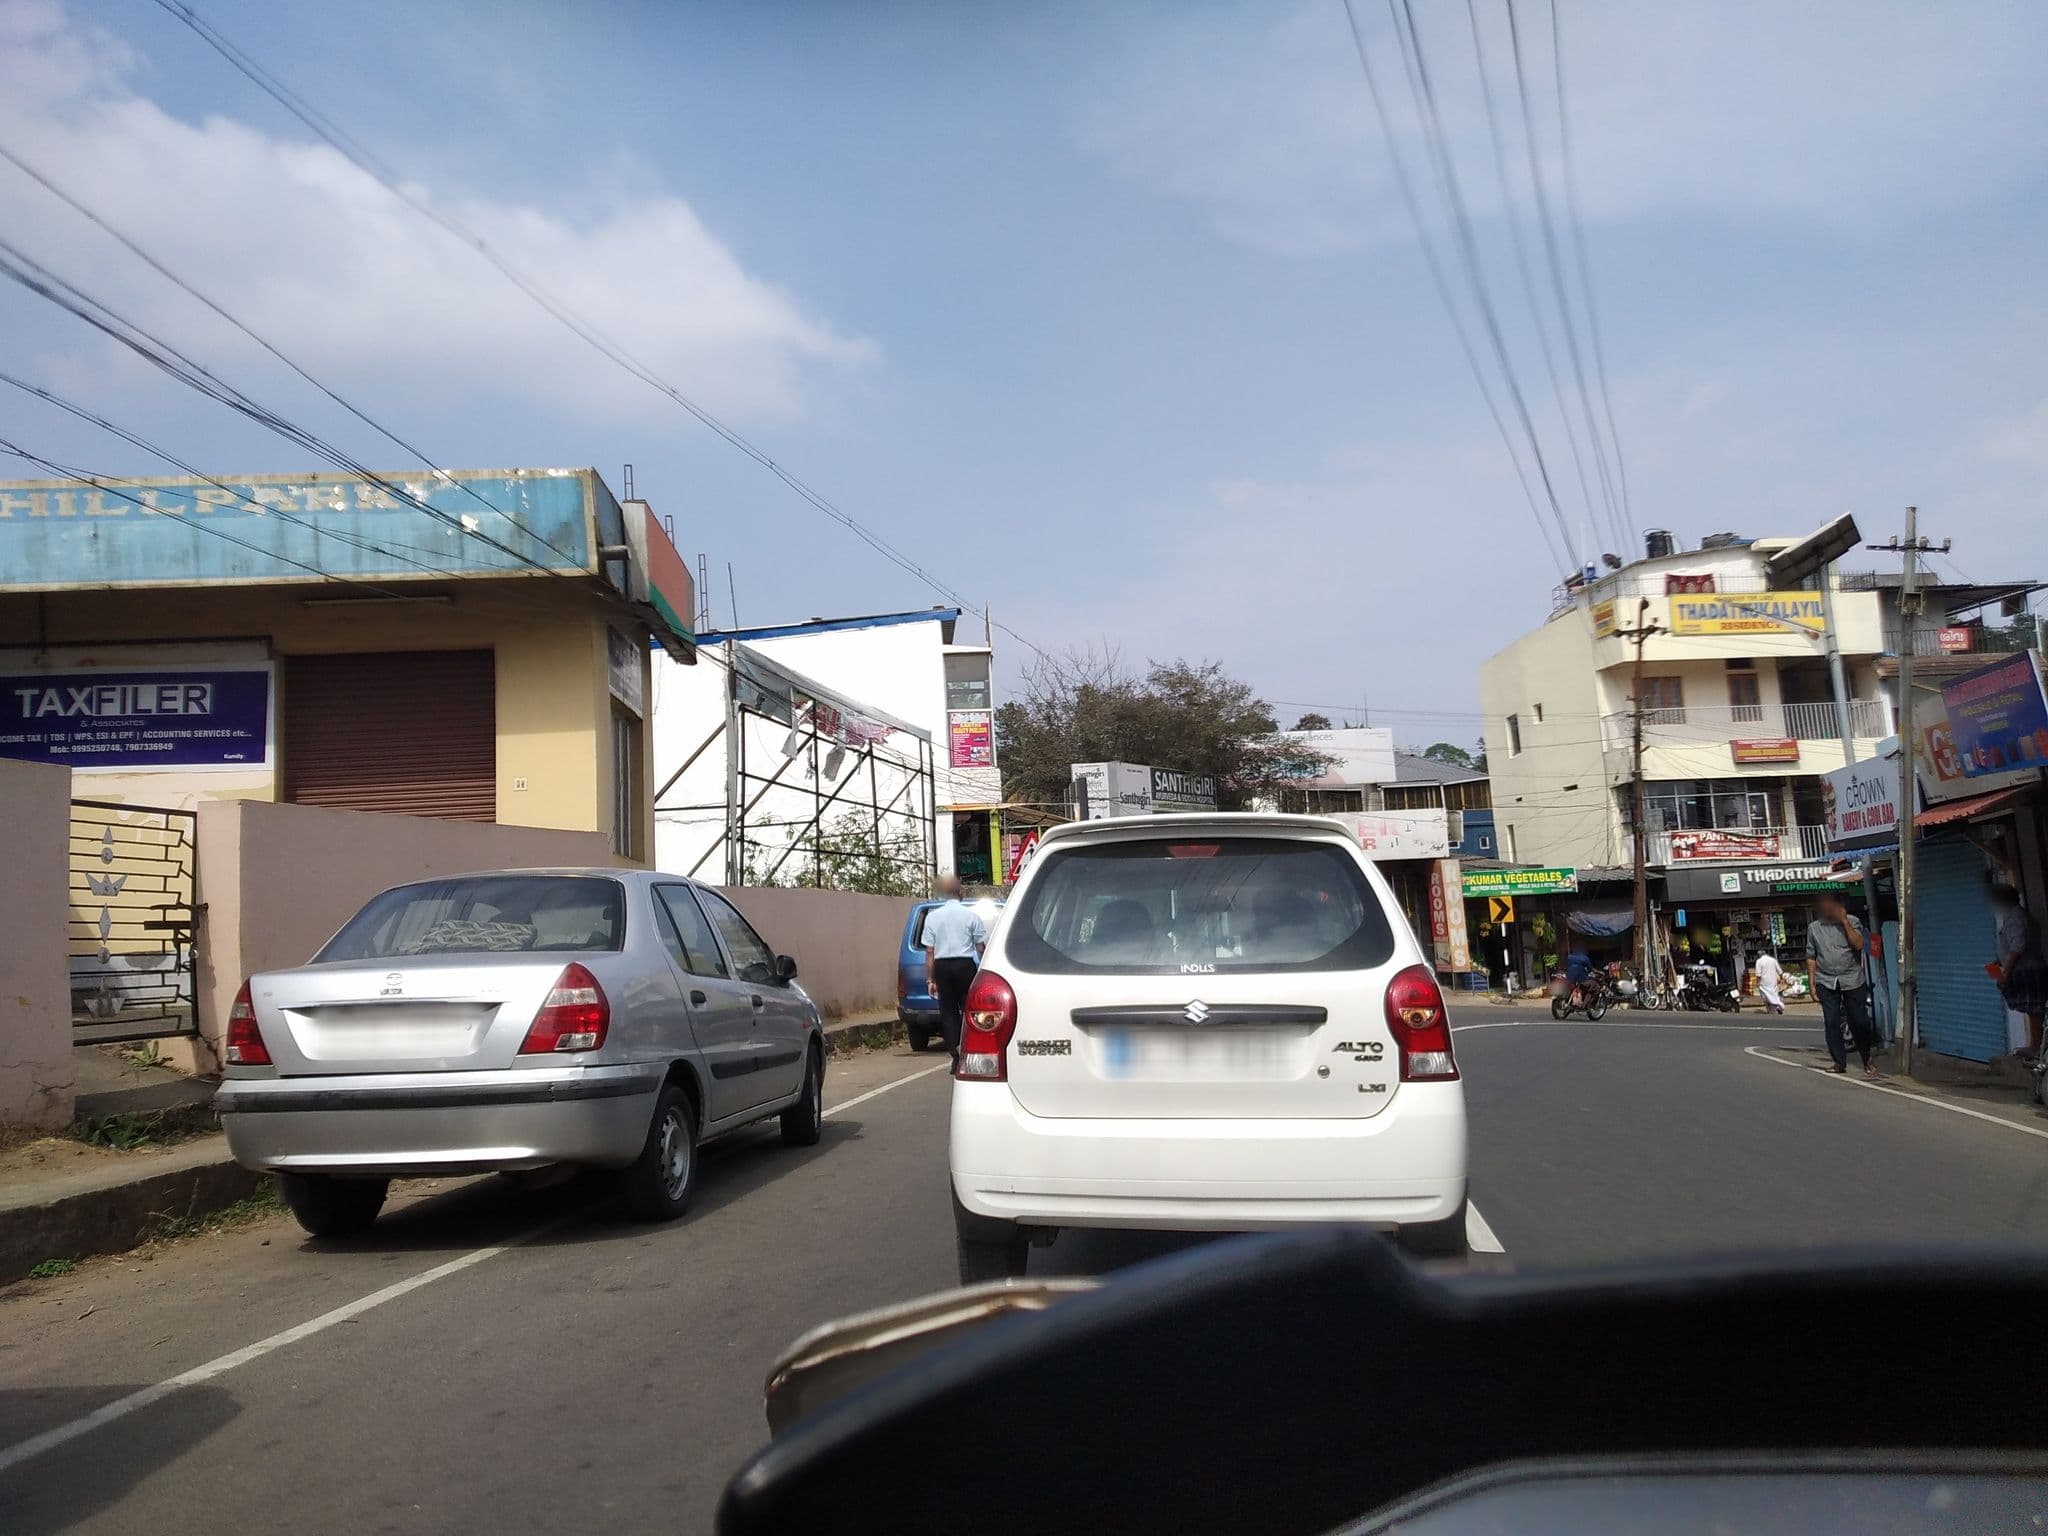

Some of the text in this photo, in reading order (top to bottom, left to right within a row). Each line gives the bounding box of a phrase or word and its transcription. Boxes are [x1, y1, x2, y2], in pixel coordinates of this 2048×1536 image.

[0, 734, 24, 743] COME
[27, 734, 41, 742] TAX
[142, 730, 192, 738] ACCOUNTING
[193, 729, 231, 737] SERVICES
[1154, 771, 1214, 796] SANTHIGIRI
[1846, 776, 1886, 808] CROWN
[1470, 874, 1502, 886] KUMAR
[1504, 871, 1562, 884] VEGETABLES
[1776, 881, 1847, 891] SUPERMARKE
[1431, 872, 1445, 935] ROOMS
[1331, 1041, 1384, 1053] ALTO
